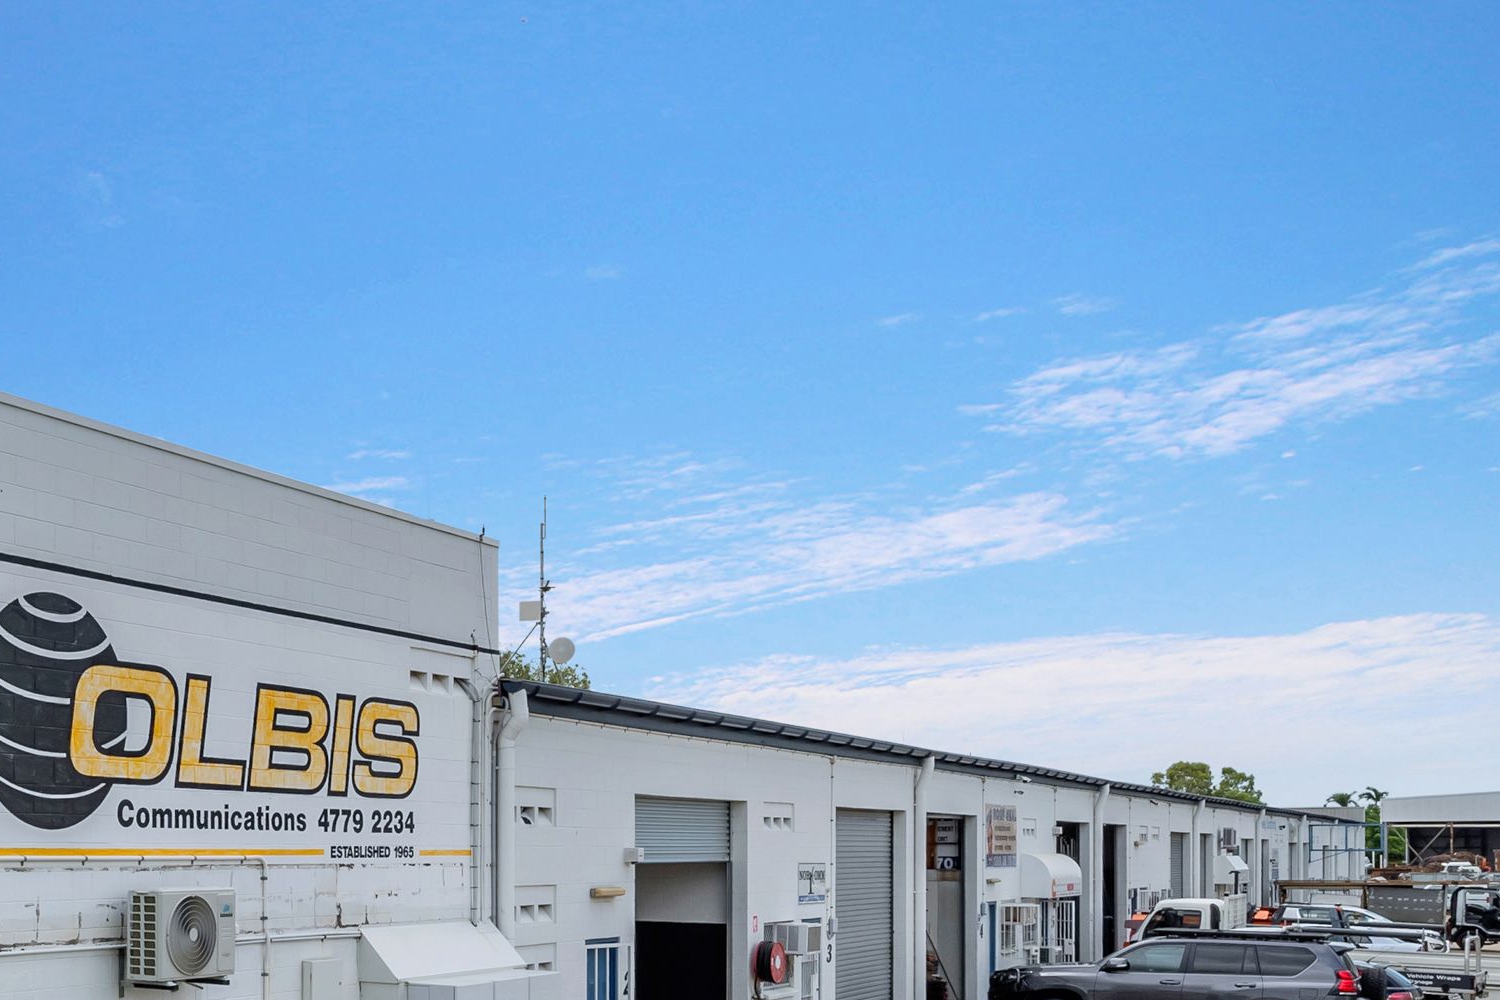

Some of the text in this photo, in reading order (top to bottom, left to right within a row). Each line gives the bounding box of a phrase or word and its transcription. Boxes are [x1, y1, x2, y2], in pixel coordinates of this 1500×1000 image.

[69, 660, 420, 799] OLBIS
[116, 799, 415, 834] Communications 4779 2234
[330, 846, 414, 859] ESTABLISHED 1965
[826, 944, 833, 963] 3
